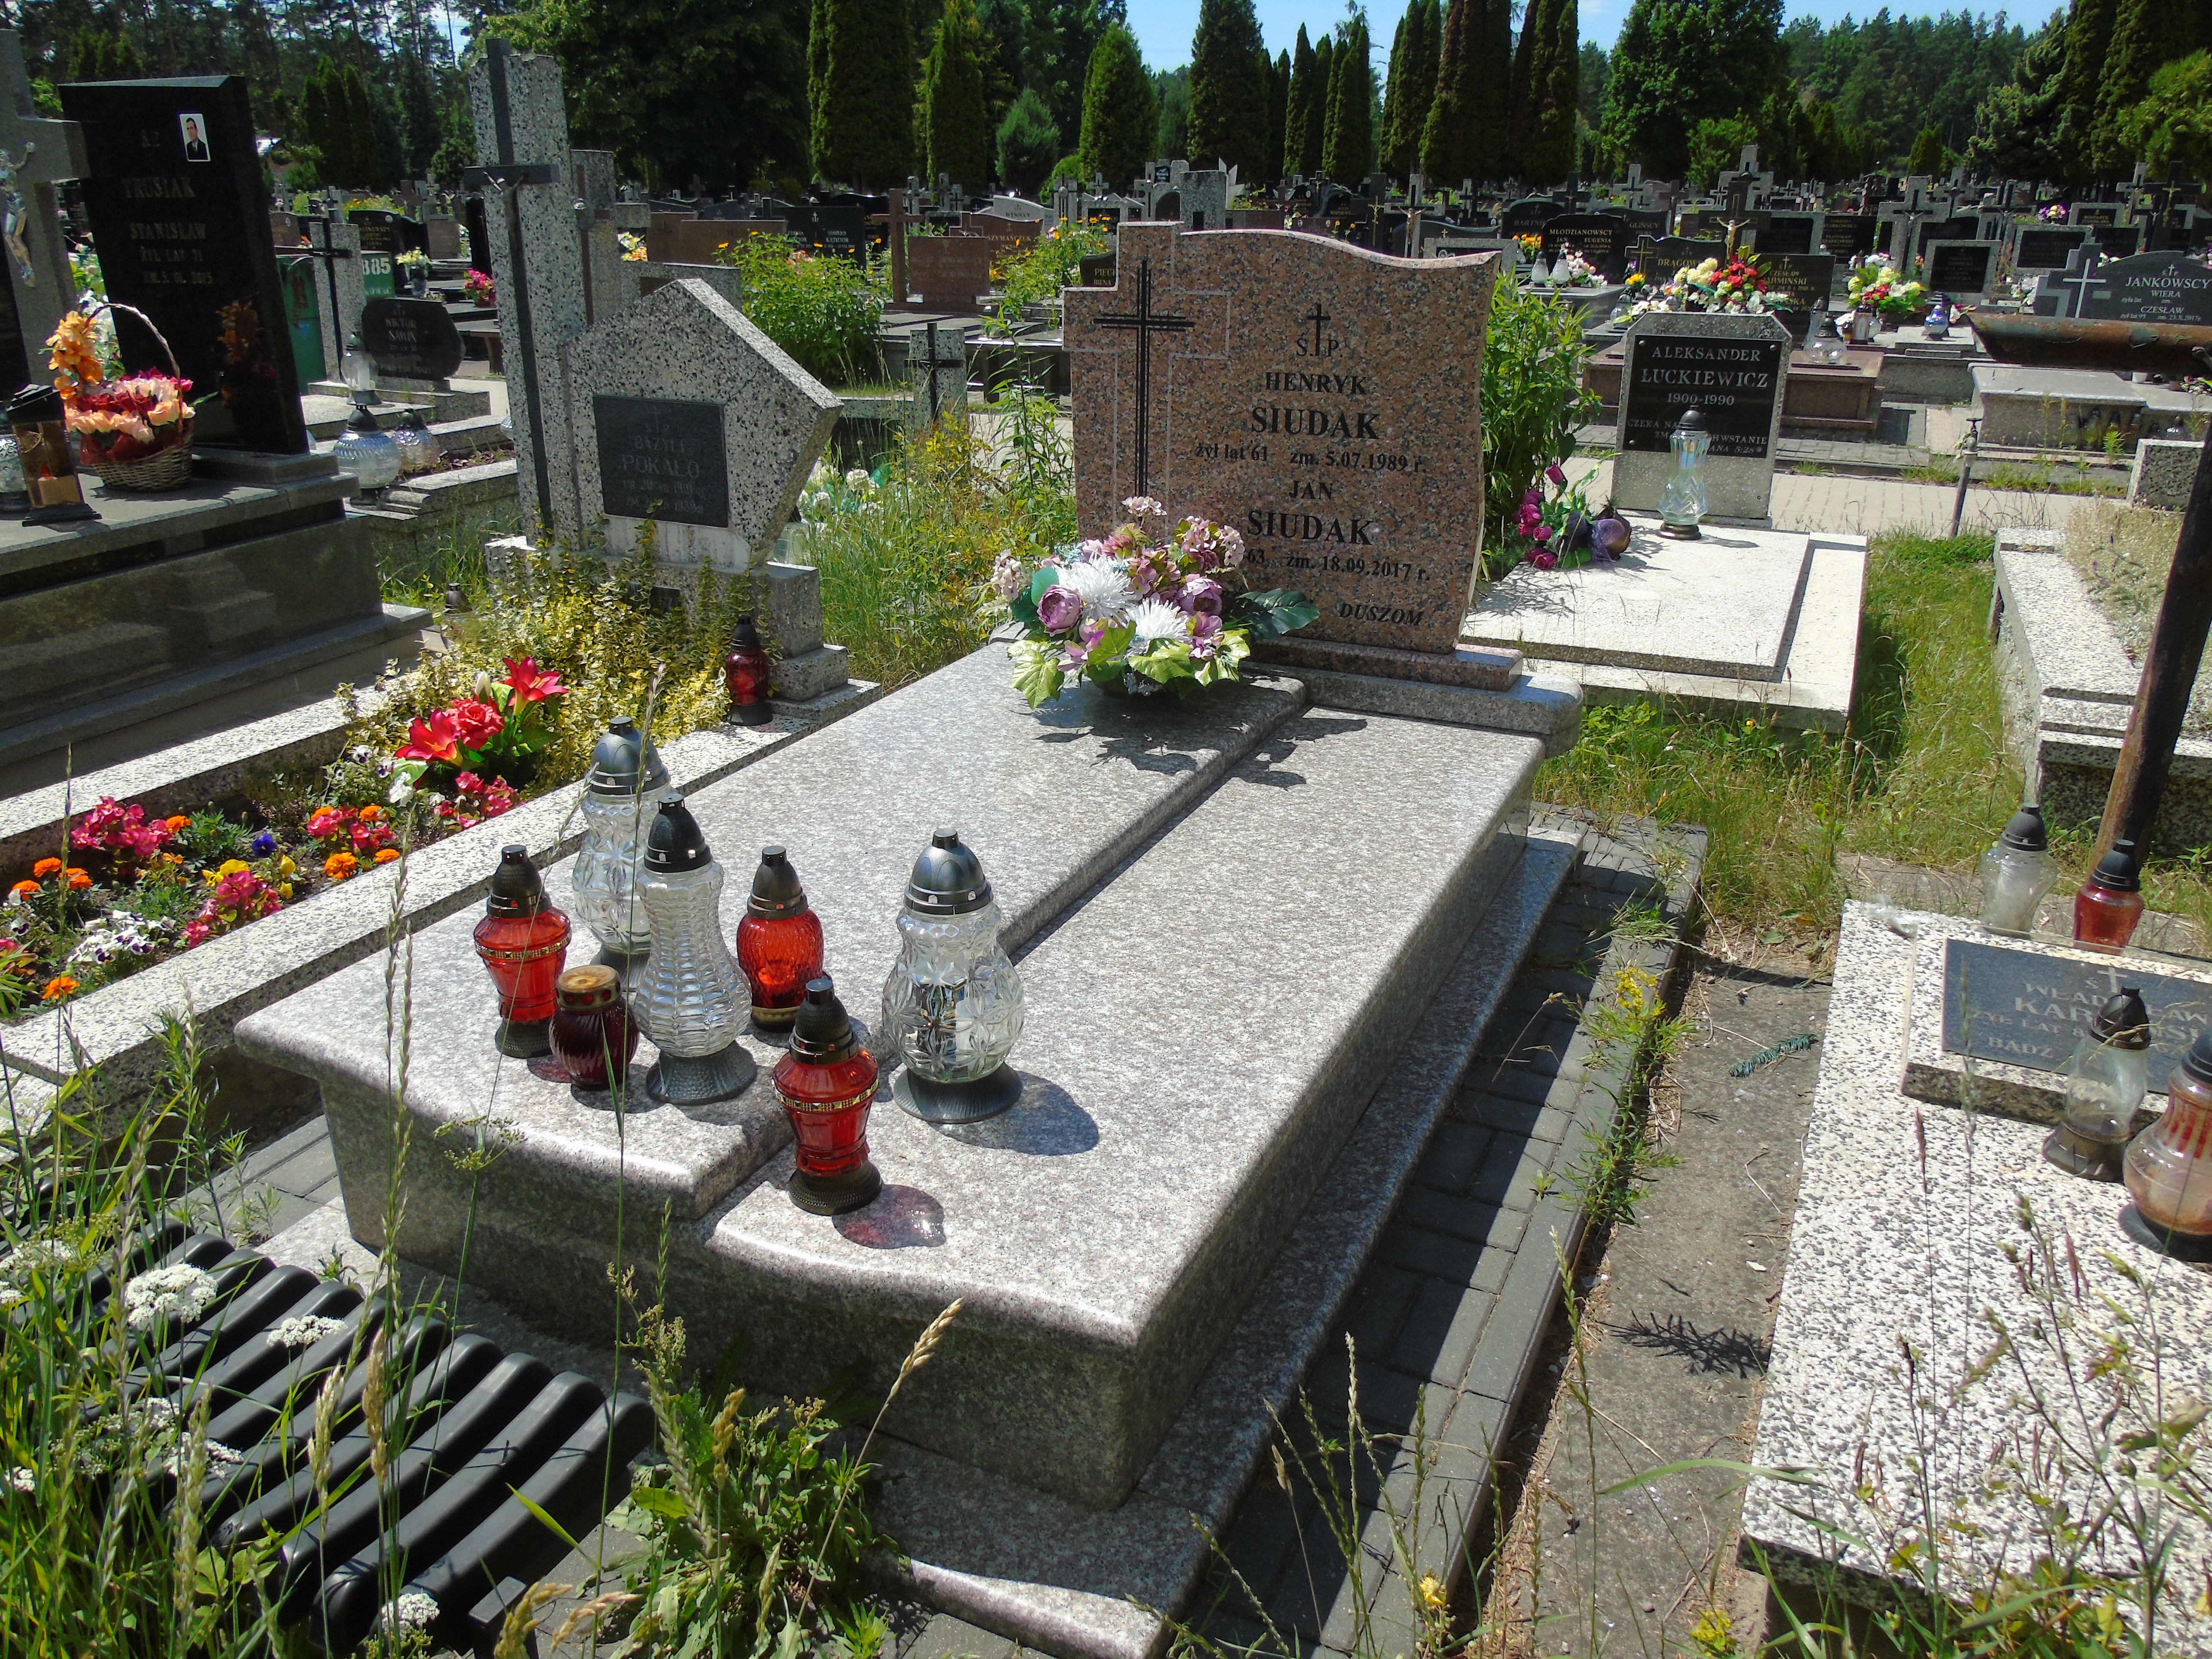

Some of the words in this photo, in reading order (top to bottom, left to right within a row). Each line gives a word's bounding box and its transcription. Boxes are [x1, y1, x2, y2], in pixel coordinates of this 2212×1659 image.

[130, 222, 205, 240] STANISŁAW
[1658, 258, 1698, 269] DRĄGOW
[2125, 276, 2211, 289] JANKOWSCY
[2140, 305, 2185, 314] CZESŁAW
[1652, 346, 1761, 362] ALEKSANDER
[1266, 372, 1368, 396] HENRYK
[1641, 368, 1768, 388] ŁUCKIEWICZ
[1667, 393, 1735, 406] 1900-1990
[1251, 407, 1381, 440] SIUDAK
[1627, 419, 1659, 428] CZEKA
[1196, 443, 1219, 459] żył
[1224, 444, 1246, 461] lat
[1251, 445, 1268, 461] 61
[1290, 451, 1319, 465] zm.
[1326, 450, 1409, 471] 5.07.1989
[1288, 480, 1333, 500] JAN
[1247, 510, 1374, 546] SIUDAK
[1247, 549, 1265, 565] 63
[1286, 556, 1316, 570] zm.
[1323, 555, 1412, 579] 18.09.2017
[1339, 602, 1425, 626] DUSZOM
[2022, 1019, 2062, 1033] LAT
